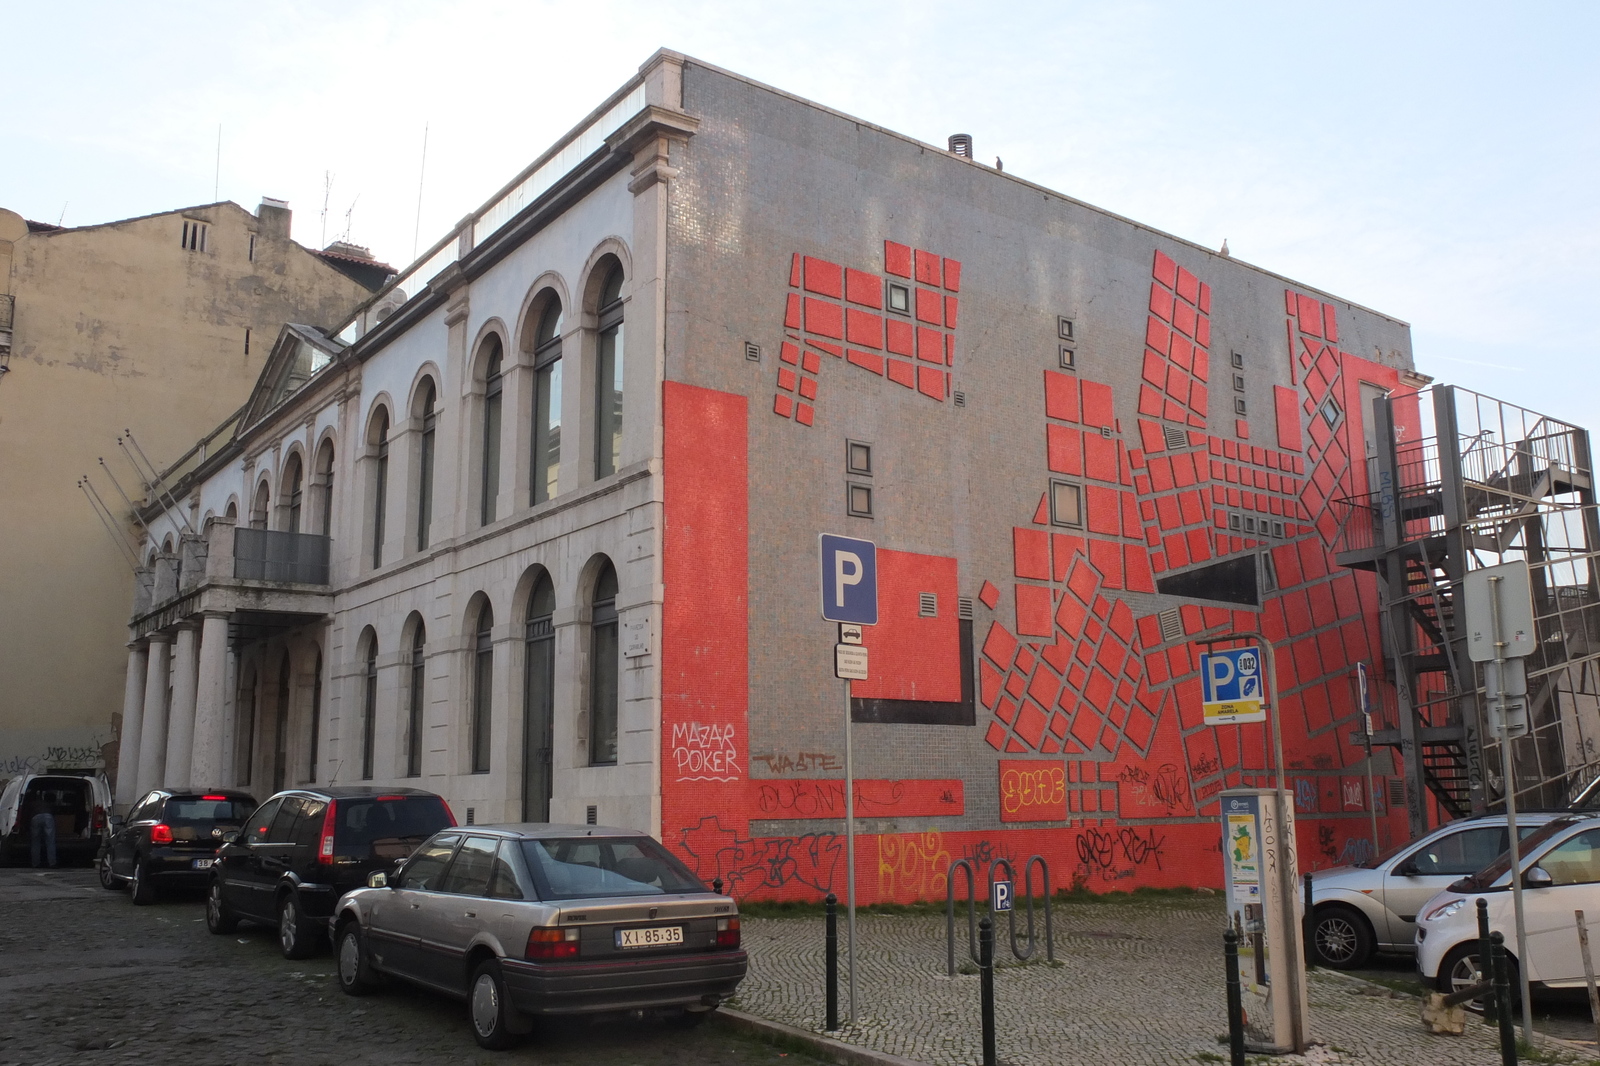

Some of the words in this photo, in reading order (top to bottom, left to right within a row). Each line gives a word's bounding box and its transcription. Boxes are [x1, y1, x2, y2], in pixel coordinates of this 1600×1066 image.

[835, 550, 863, 607] P
[1243, 657, 1255, 670] 032
[1208, 656, 1235, 702] P
[672, 722, 736, 750] MAZAR
[673, 747, 742, 774] POKER
[996, 884, 1008, 909] P
